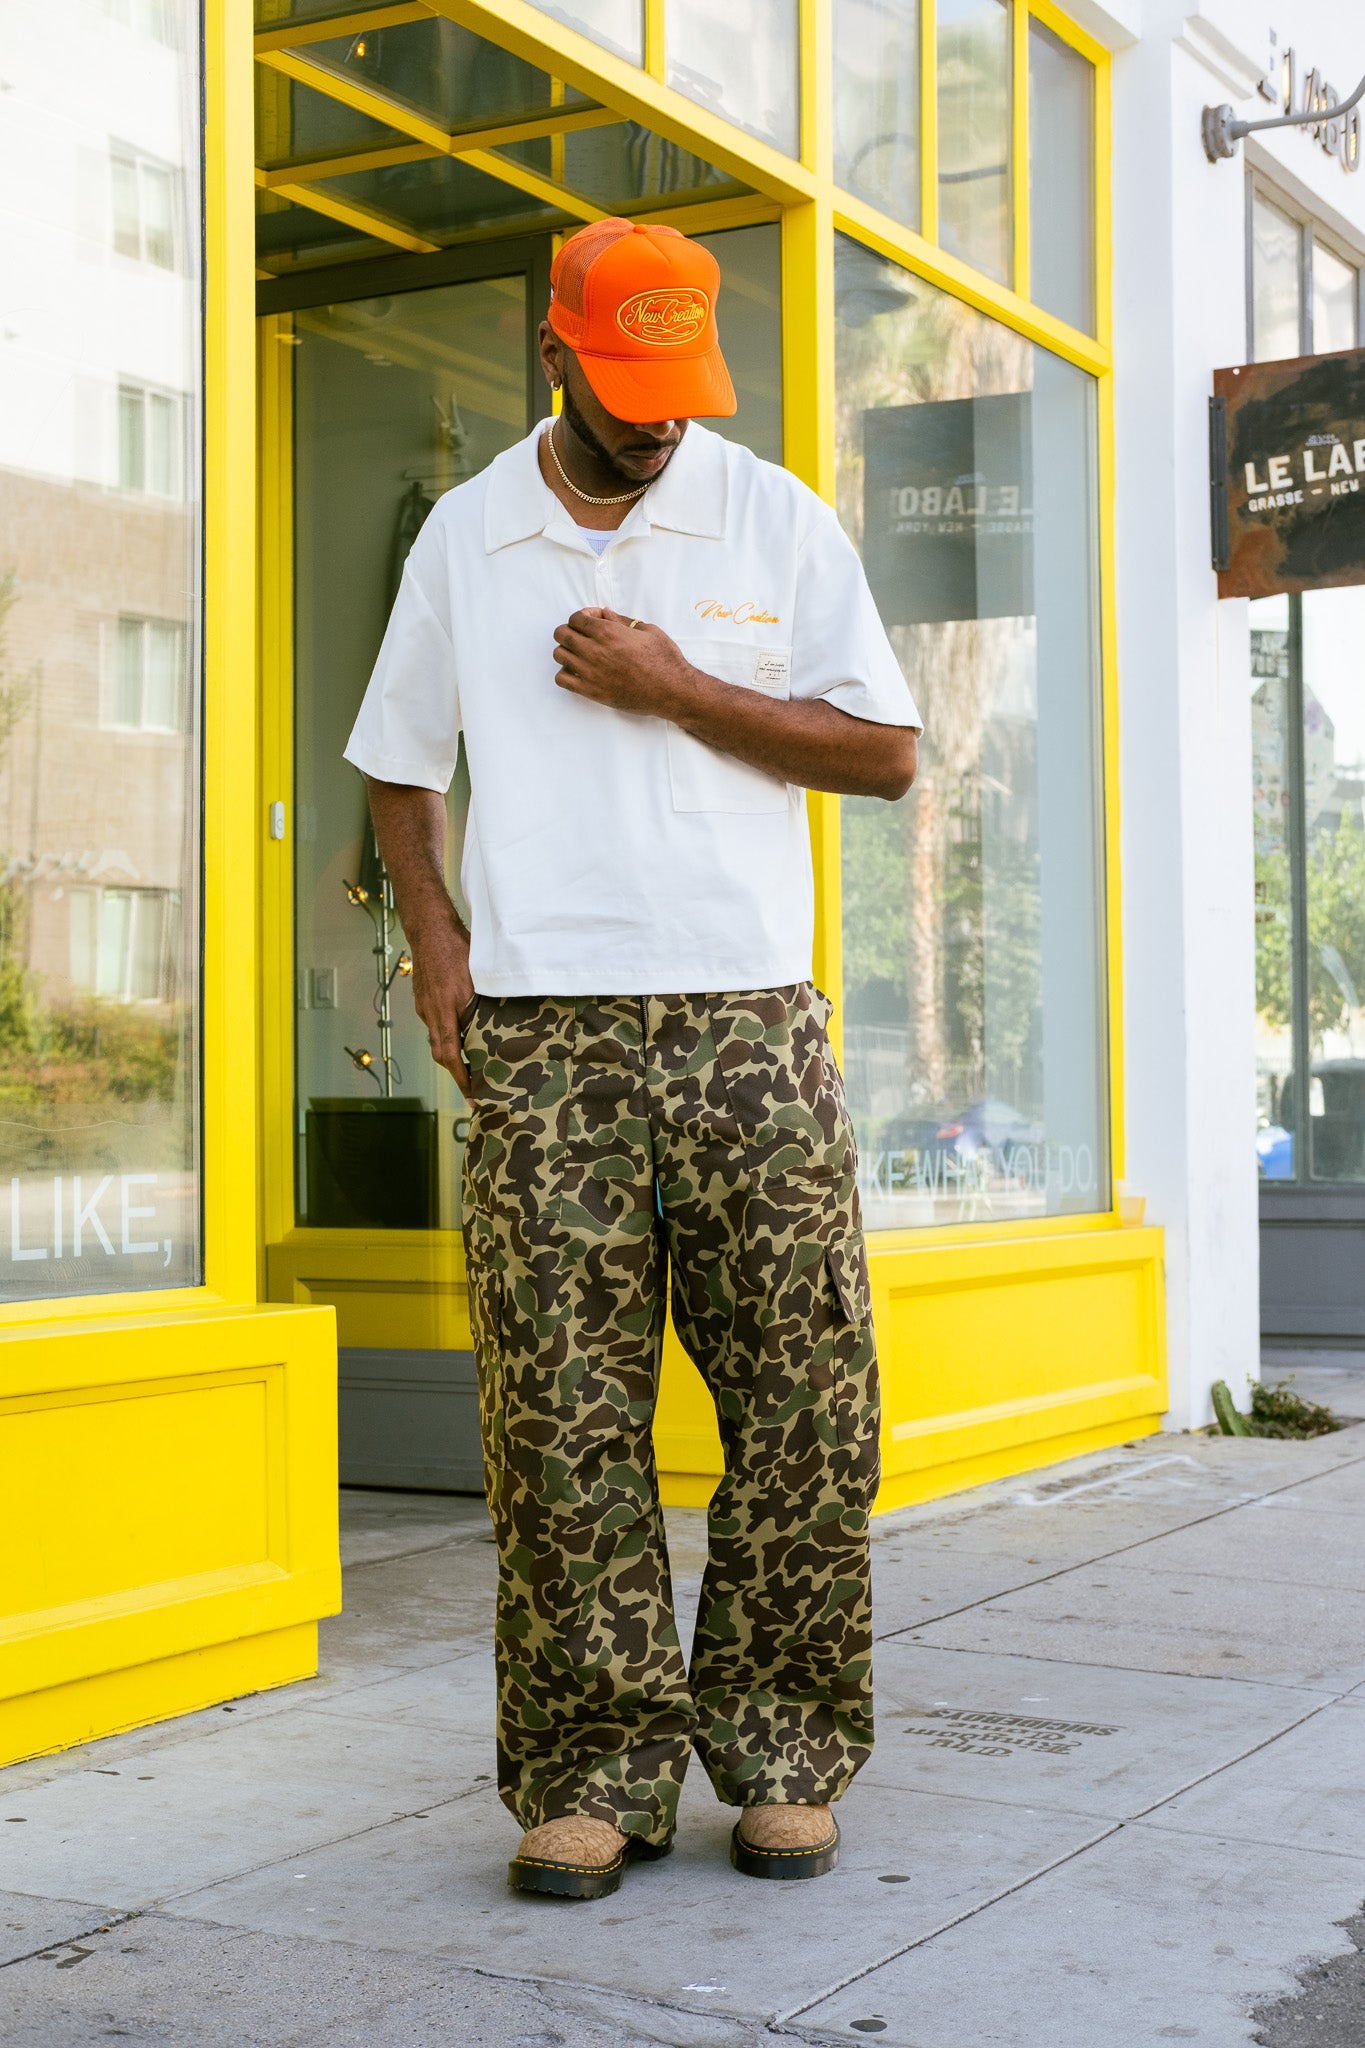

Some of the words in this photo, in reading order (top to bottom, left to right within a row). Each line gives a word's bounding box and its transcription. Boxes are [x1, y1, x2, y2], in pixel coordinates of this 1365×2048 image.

[625, 298, 661, 326] New
[656, 298, 705, 325] Creation
[1244, 455, 1293, 494] LE
[1248, 489, 1305, 512] GRASSE
[1330, 478, 1360, 496] NEW
[695, 599, 733, 621] New
[998, 1145, 1050, 1197] YOU
[11, 1174, 172, 1267] LIKE,
[902, 1727, 1082, 1755] Kingdom
